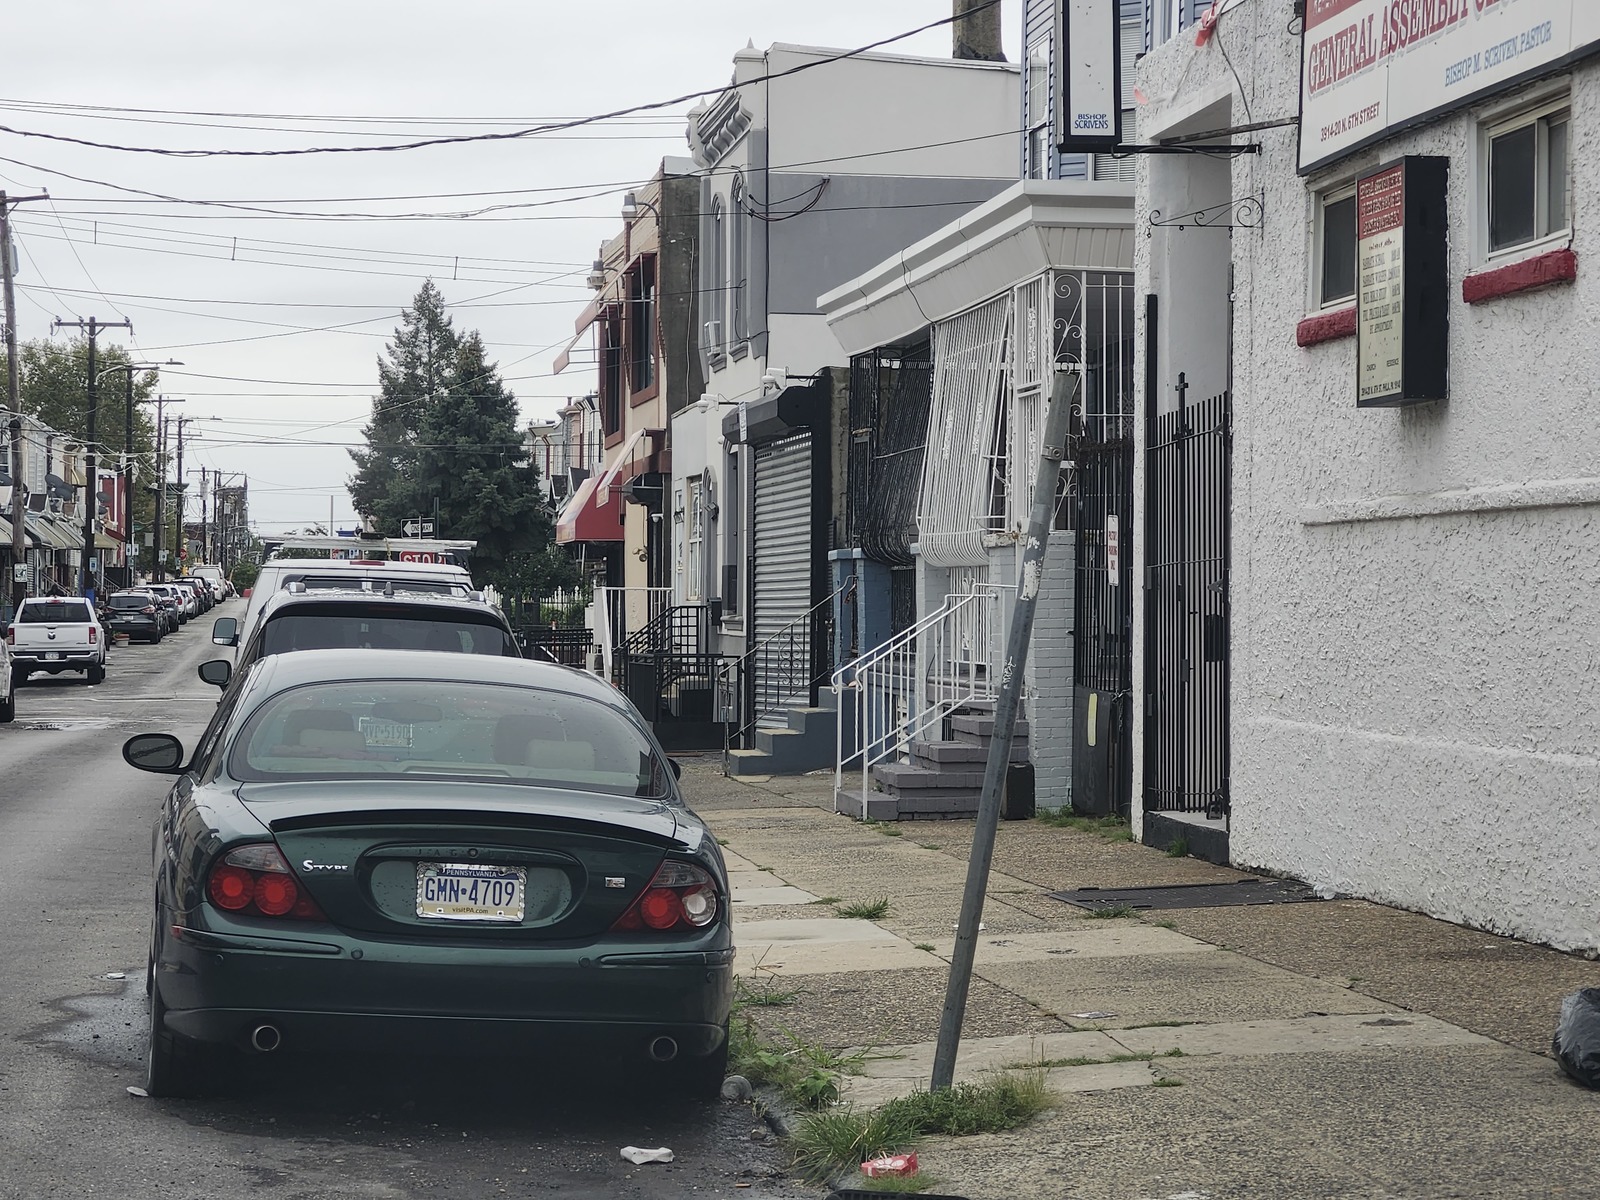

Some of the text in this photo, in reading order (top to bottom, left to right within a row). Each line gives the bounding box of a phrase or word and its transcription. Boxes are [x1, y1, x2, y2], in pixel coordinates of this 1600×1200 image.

[1308, 13, 1377, 94] GENERAL
[1445, 58, 1472, 88] BISHOP
[1519, 20, 1552, 54] PASTOR
[1074, 120, 1109, 129] SCRIVENS
[1348, 112, 1359, 130] 6TH
[1360, 101, 1380, 125] STREET
[446, 869, 498, 878] PENNSYLVANIA
[452, 906, 489, 914] visitPA.com
